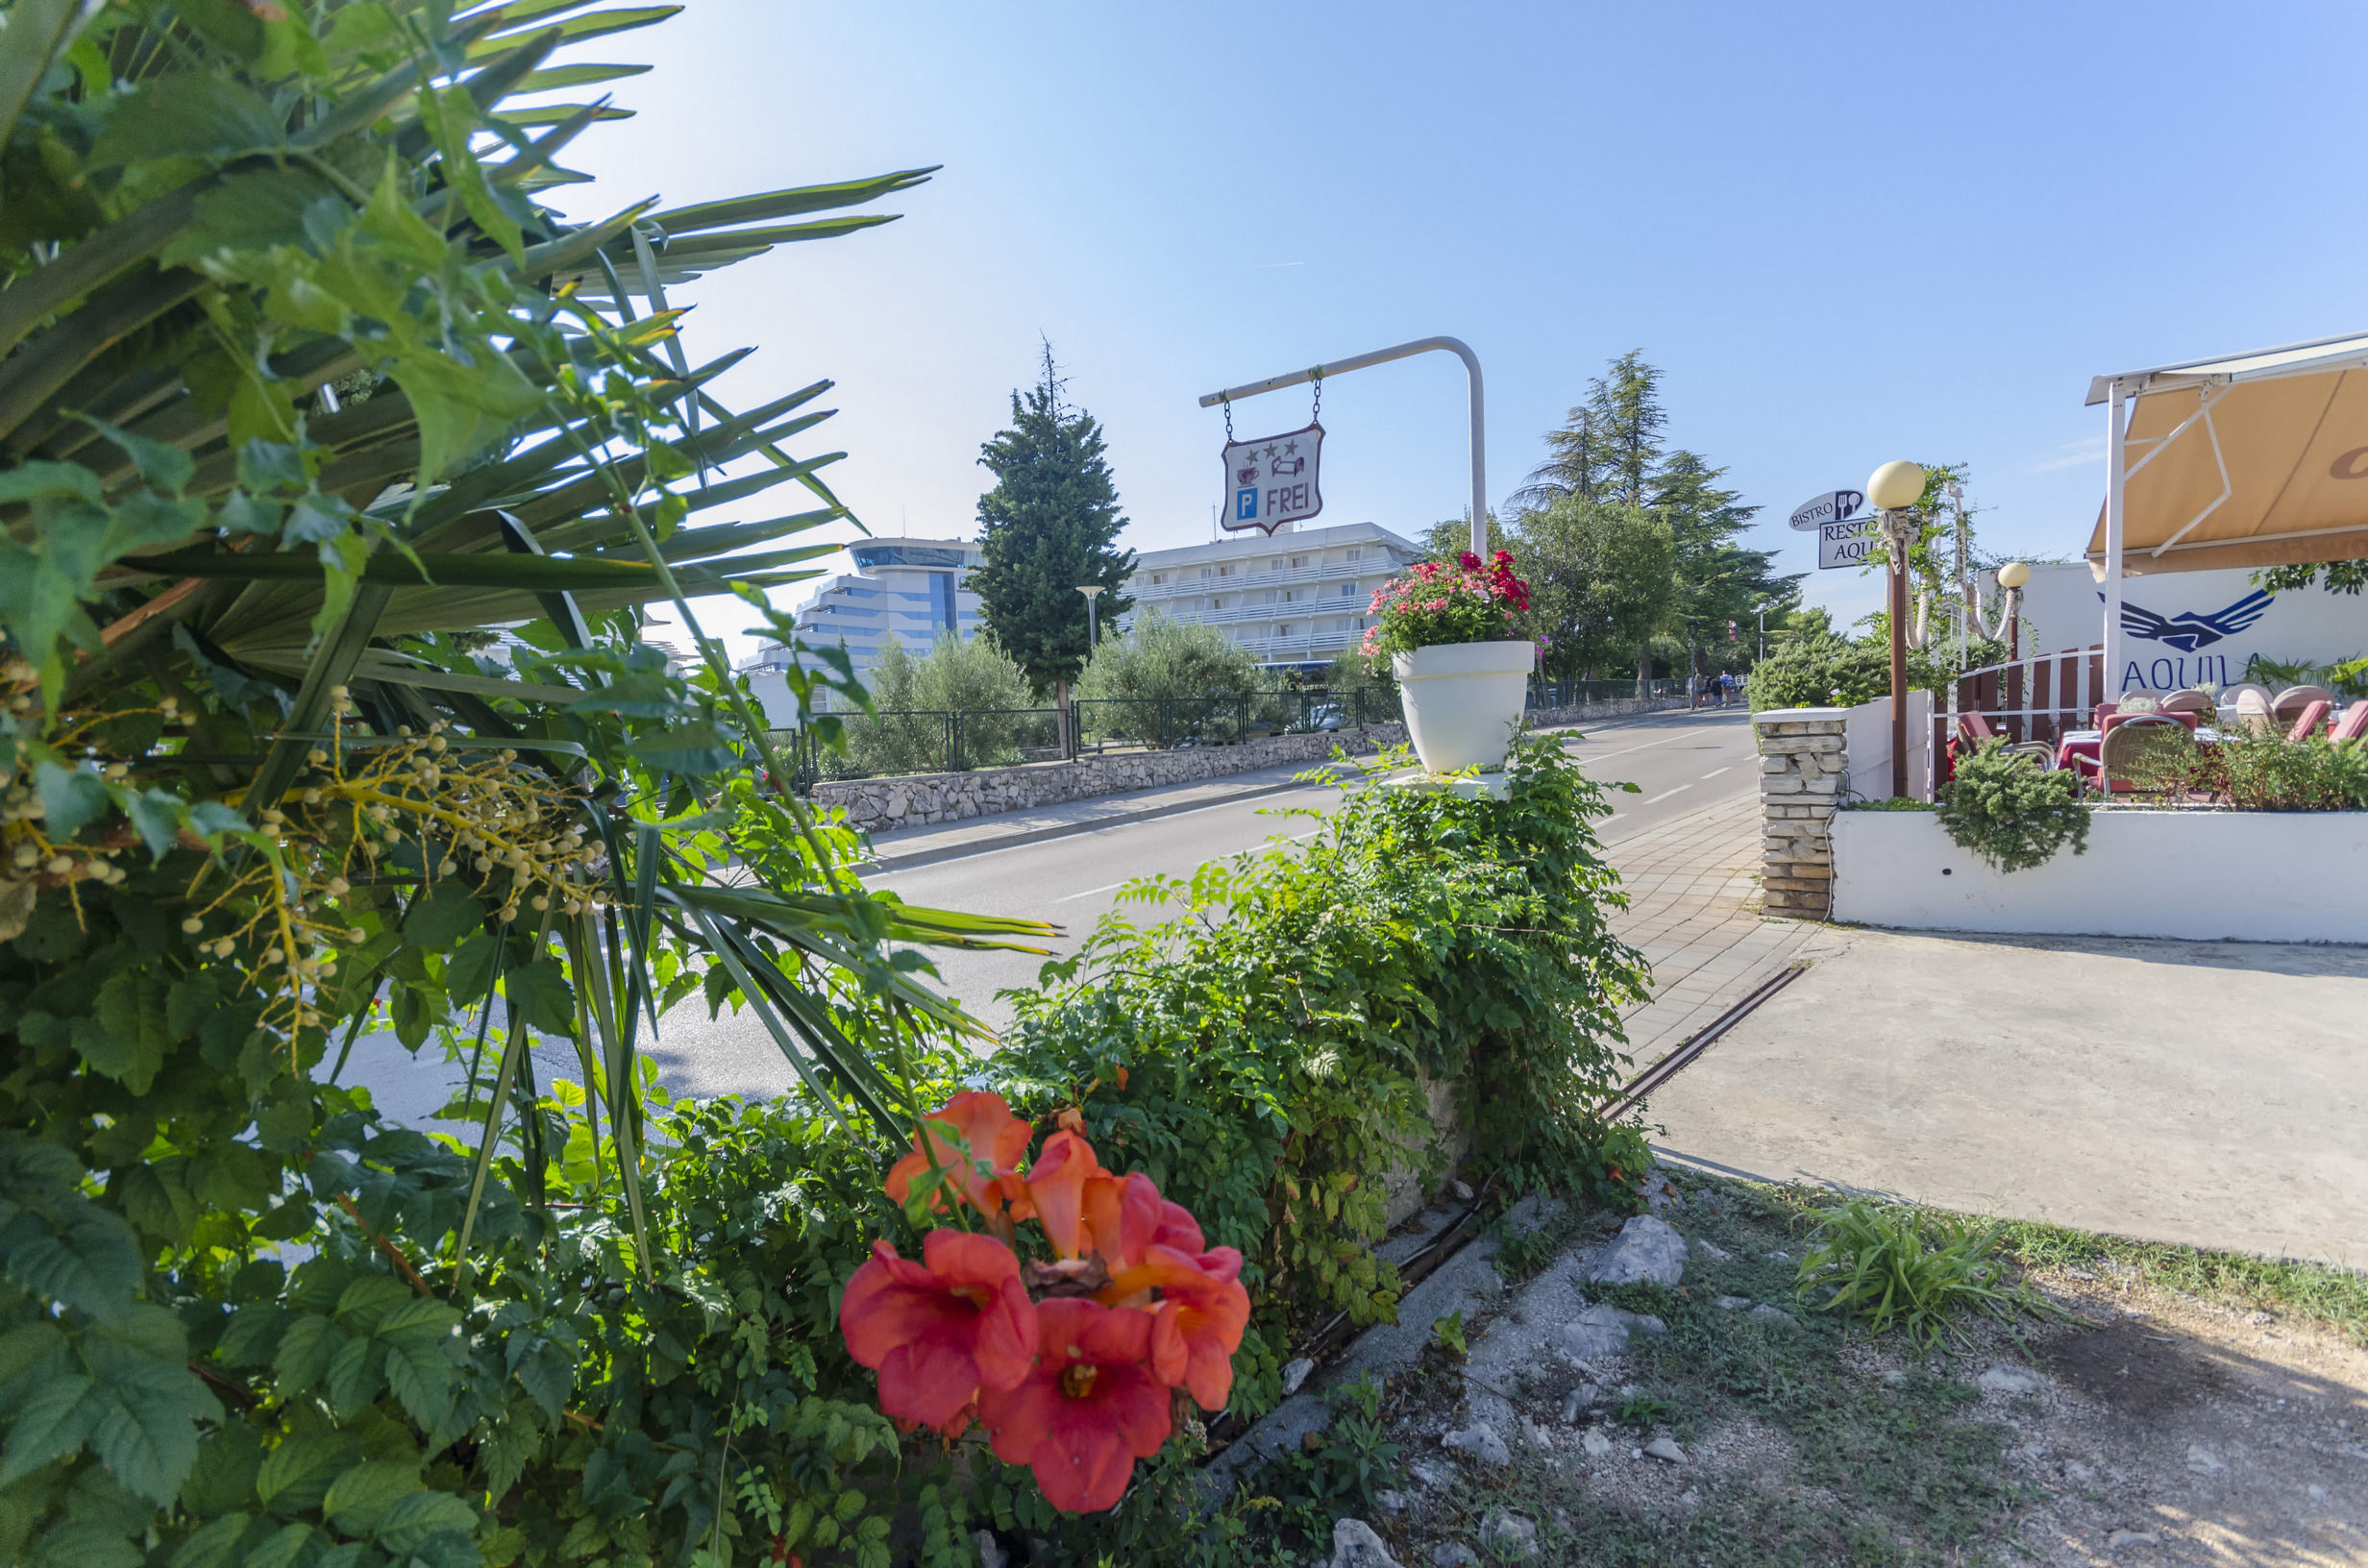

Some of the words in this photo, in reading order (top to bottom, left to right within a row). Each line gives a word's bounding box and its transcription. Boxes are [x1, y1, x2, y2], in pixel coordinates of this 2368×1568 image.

[1242, 493, 1252, 516] P
[1267, 482, 1309, 516] FREI
[1791, 502, 1833, 527] BISTRO
[1835, 541, 1874, 561] AQU
